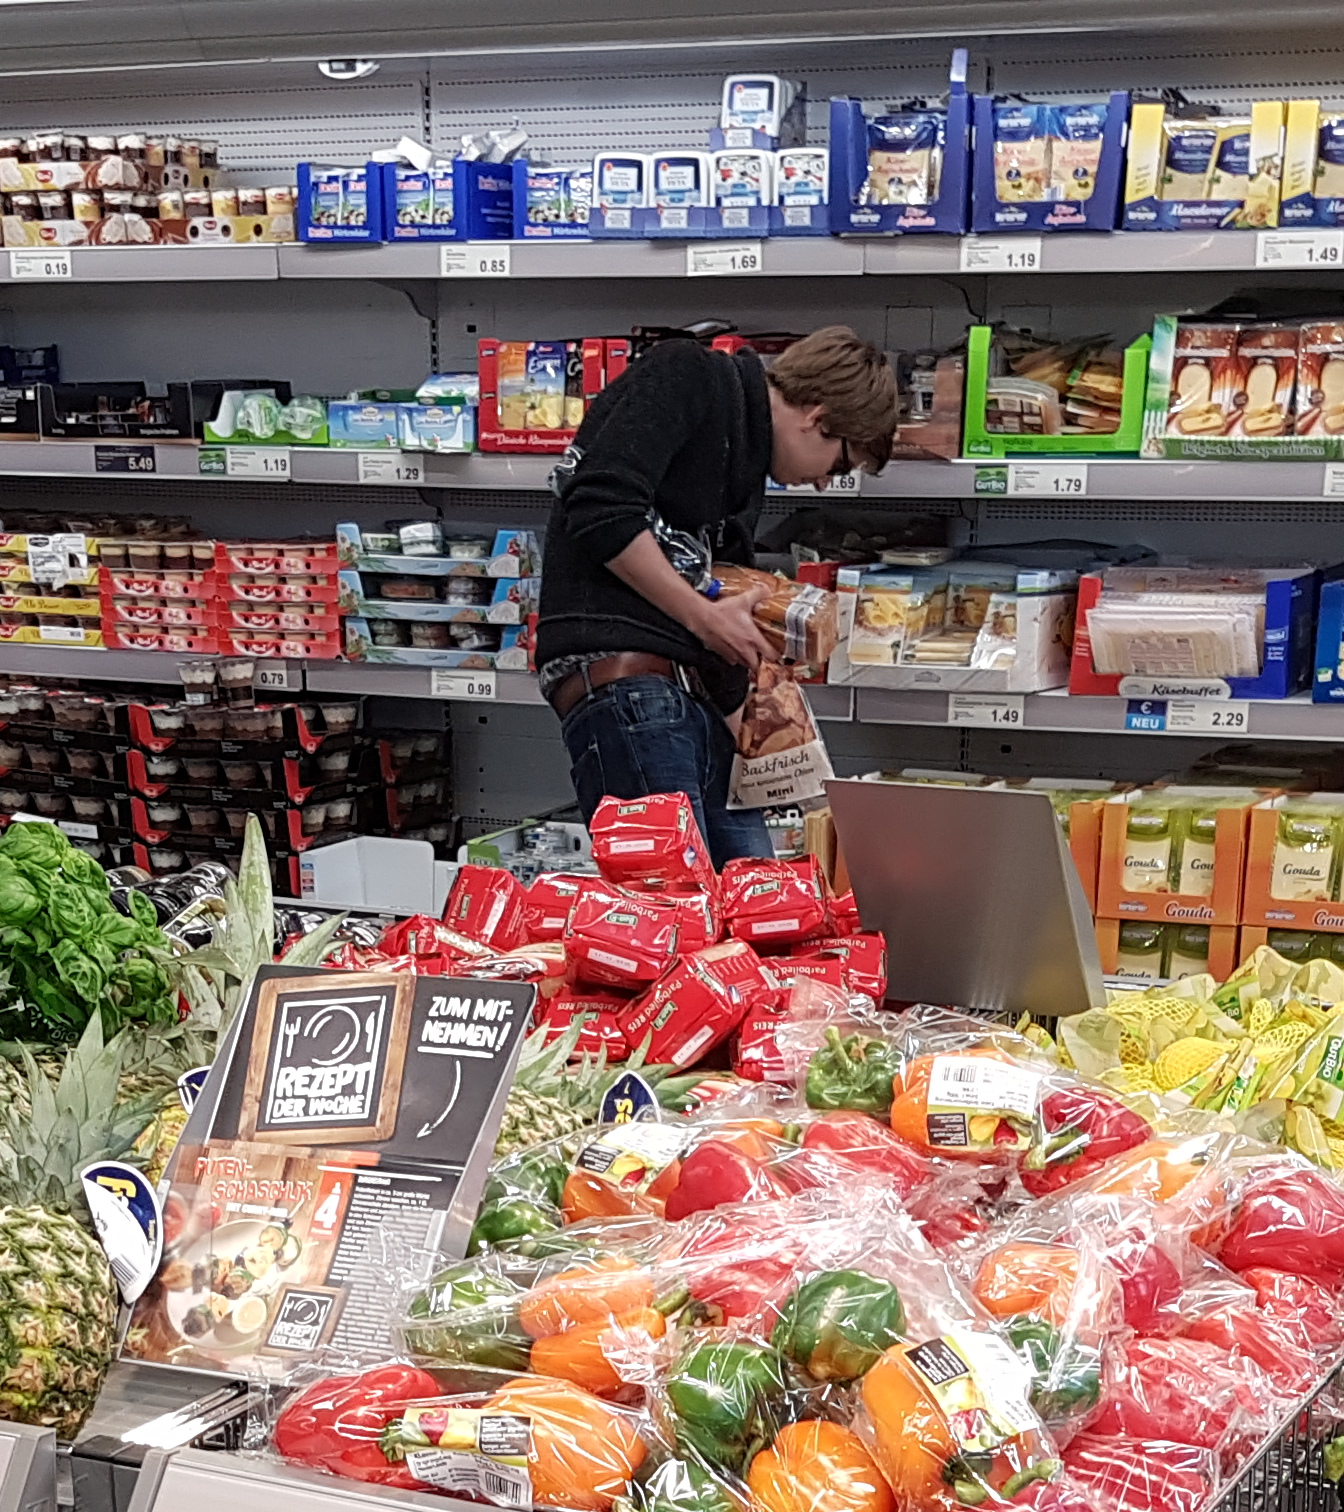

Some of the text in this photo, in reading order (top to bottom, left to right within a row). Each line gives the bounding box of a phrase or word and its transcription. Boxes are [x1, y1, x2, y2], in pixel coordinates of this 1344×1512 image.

[1006, 254, 1036, 267] 1.19
[1307, 248, 1339, 261] 1.49
[44, 263, 68, 275] 0.19
[480, 261, 506, 272] 0.85
[730, 255, 757, 270] 1.69
[128, 457, 154, 471] 5.49
[263, 458, 287, 471] 1.19
[396, 468, 420, 480] 1.29
[1052, 478, 1083, 492] 1.79
[467, 683, 492, 695] 0.99
[1151, 683, 1222, 697] Käsebuffet
[991, 709, 1020, 724] 1.49
[1131, 718, 1160, 728] NEU
[1211, 712, 1244, 727] 2.29
[741, 750, 810, 777] Backfrisch
[767, 786, 795, 798] Mini
[1124, 856, 1161, 869] Gouda
[1190, 858, 1215, 871] Gou
[1283, 863, 1322, 877] Gouda
[1165, 901, 1215, 920] Gouda
[428, 996, 514, 1022] ZUM MIT-
[421, 1019, 512, 1052] NEHMEN!
[276, 1062, 372, 1098] REZEPT
[272, 1097, 306, 1118] DER
[212, 1178, 314, 1202] SCHASCHLIK
